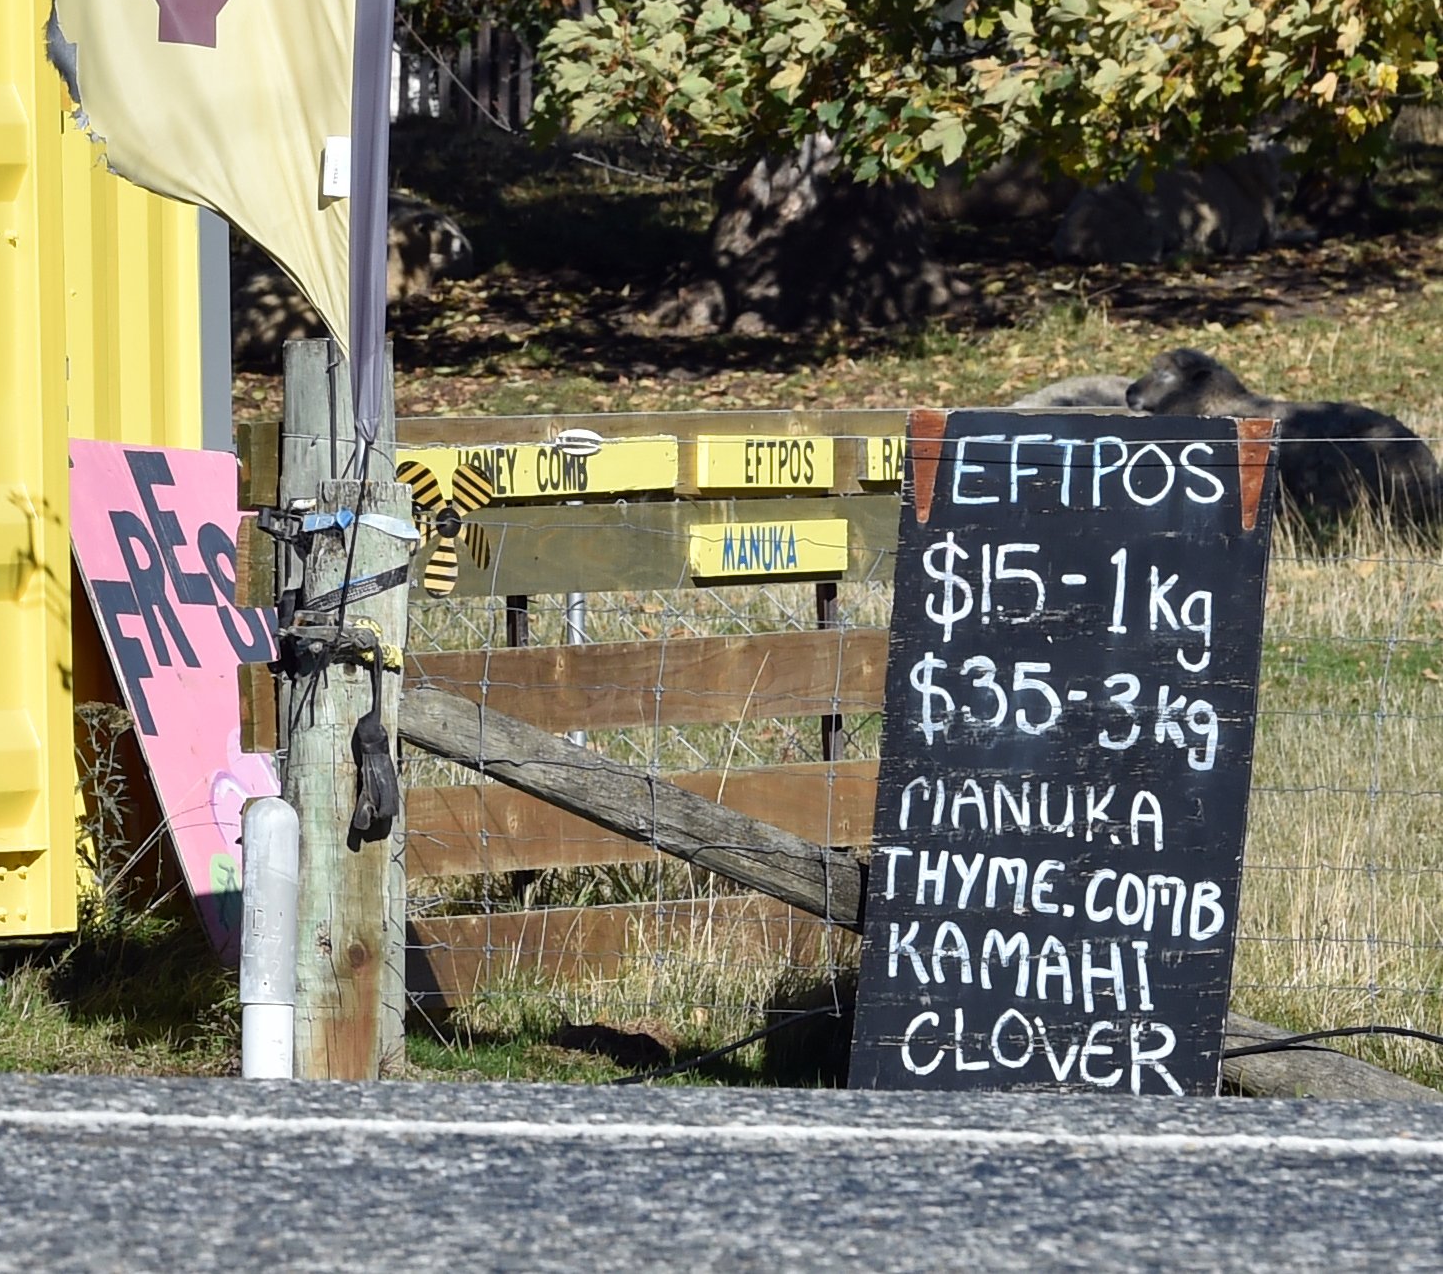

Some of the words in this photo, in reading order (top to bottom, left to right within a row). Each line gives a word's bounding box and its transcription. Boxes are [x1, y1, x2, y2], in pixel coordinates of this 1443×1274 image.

[745, 439, 815, 485] EFTPOS
[952, 432, 1225, 507] EFTPOS
[721, 526, 798, 572] MANUKA
[90, 449, 280, 736] FRES
[898, 776, 1164, 851] MANUKA
[888, 921, 1155, 1013] KAMAHI
[900, 1008, 1185, 1098] CLOVER
